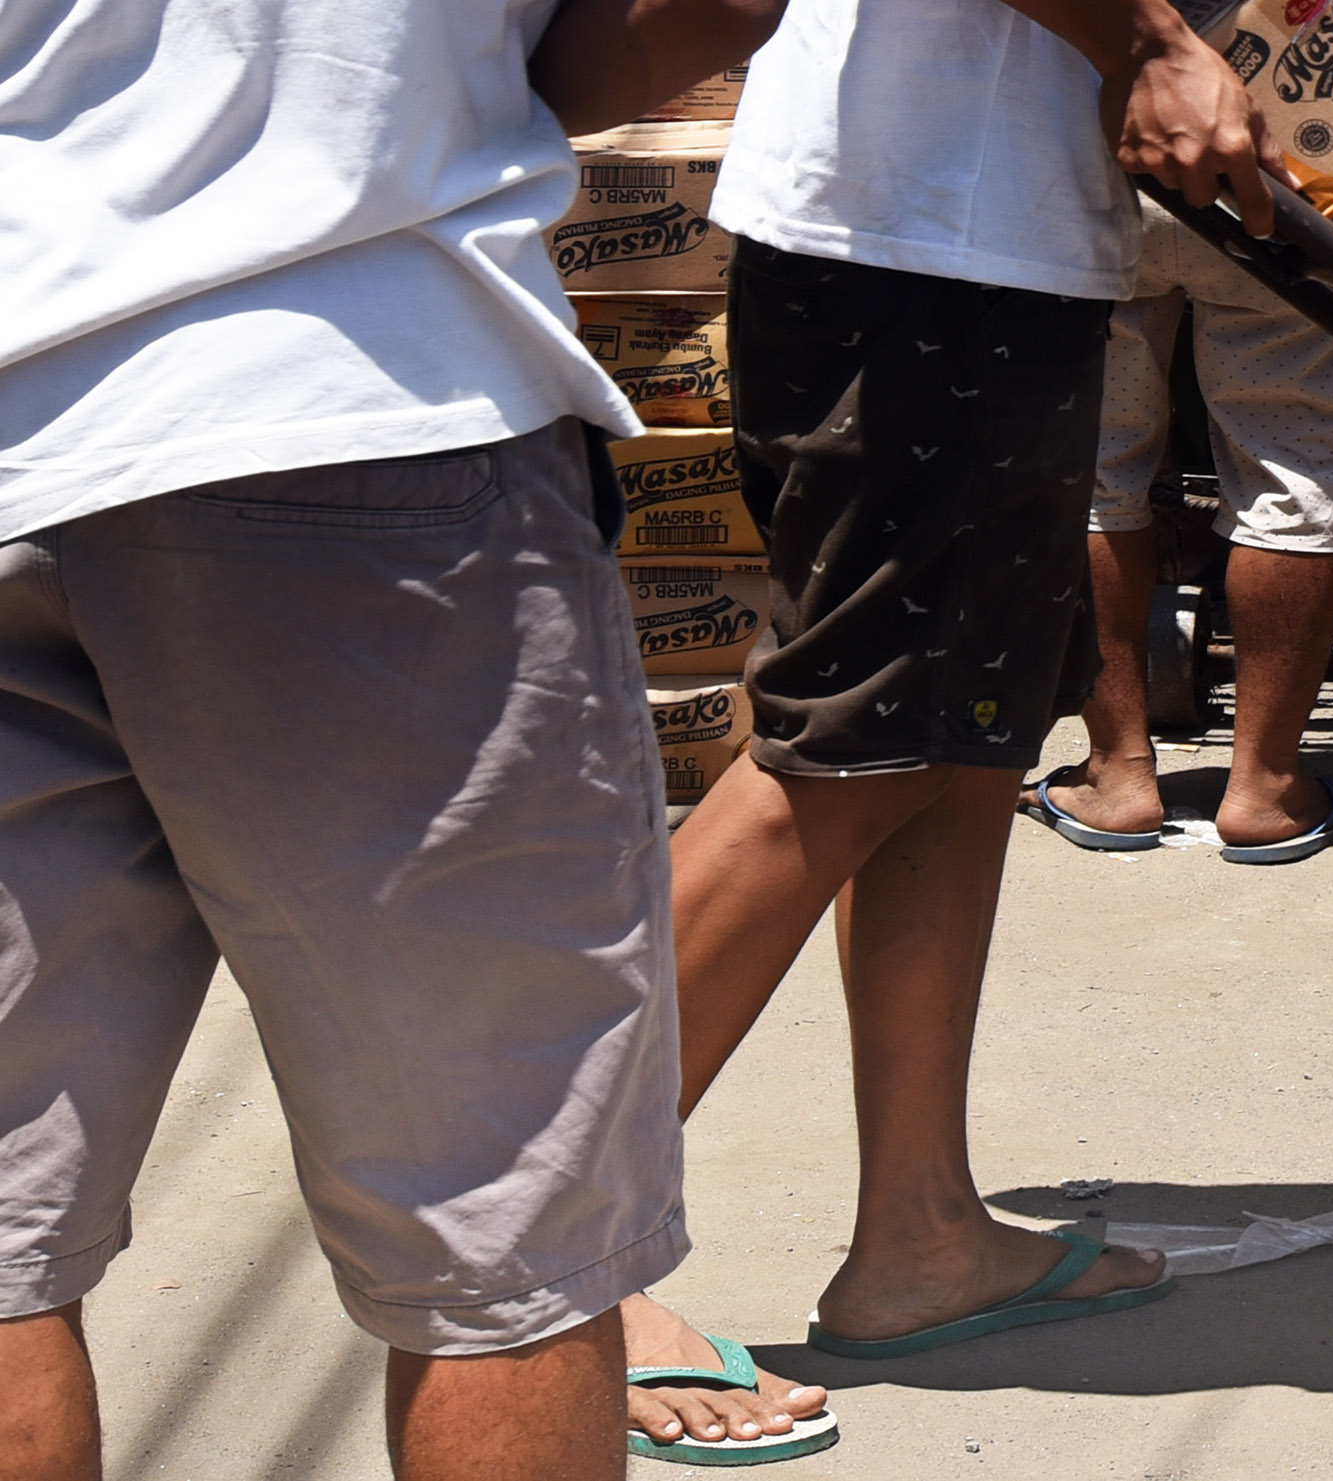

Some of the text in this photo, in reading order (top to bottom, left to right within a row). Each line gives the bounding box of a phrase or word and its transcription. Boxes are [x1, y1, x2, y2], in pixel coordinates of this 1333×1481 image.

[687, 161, 716, 173] BKS
[589, 189, 666, 204] MA5RB C
[557, 216, 642, 239] DAGING PILIHAN
[557, 218, 710, 275] Masako
[666, 479, 742, 500] DAGING PILIHA
[644, 510, 722, 526] MA5RB C
[638, 583, 714, 599] MA5RB C
[640, 608, 757, 656] Masa
[652, 688, 730, 730] sako
[687, 725, 729, 742] PILIHAN
